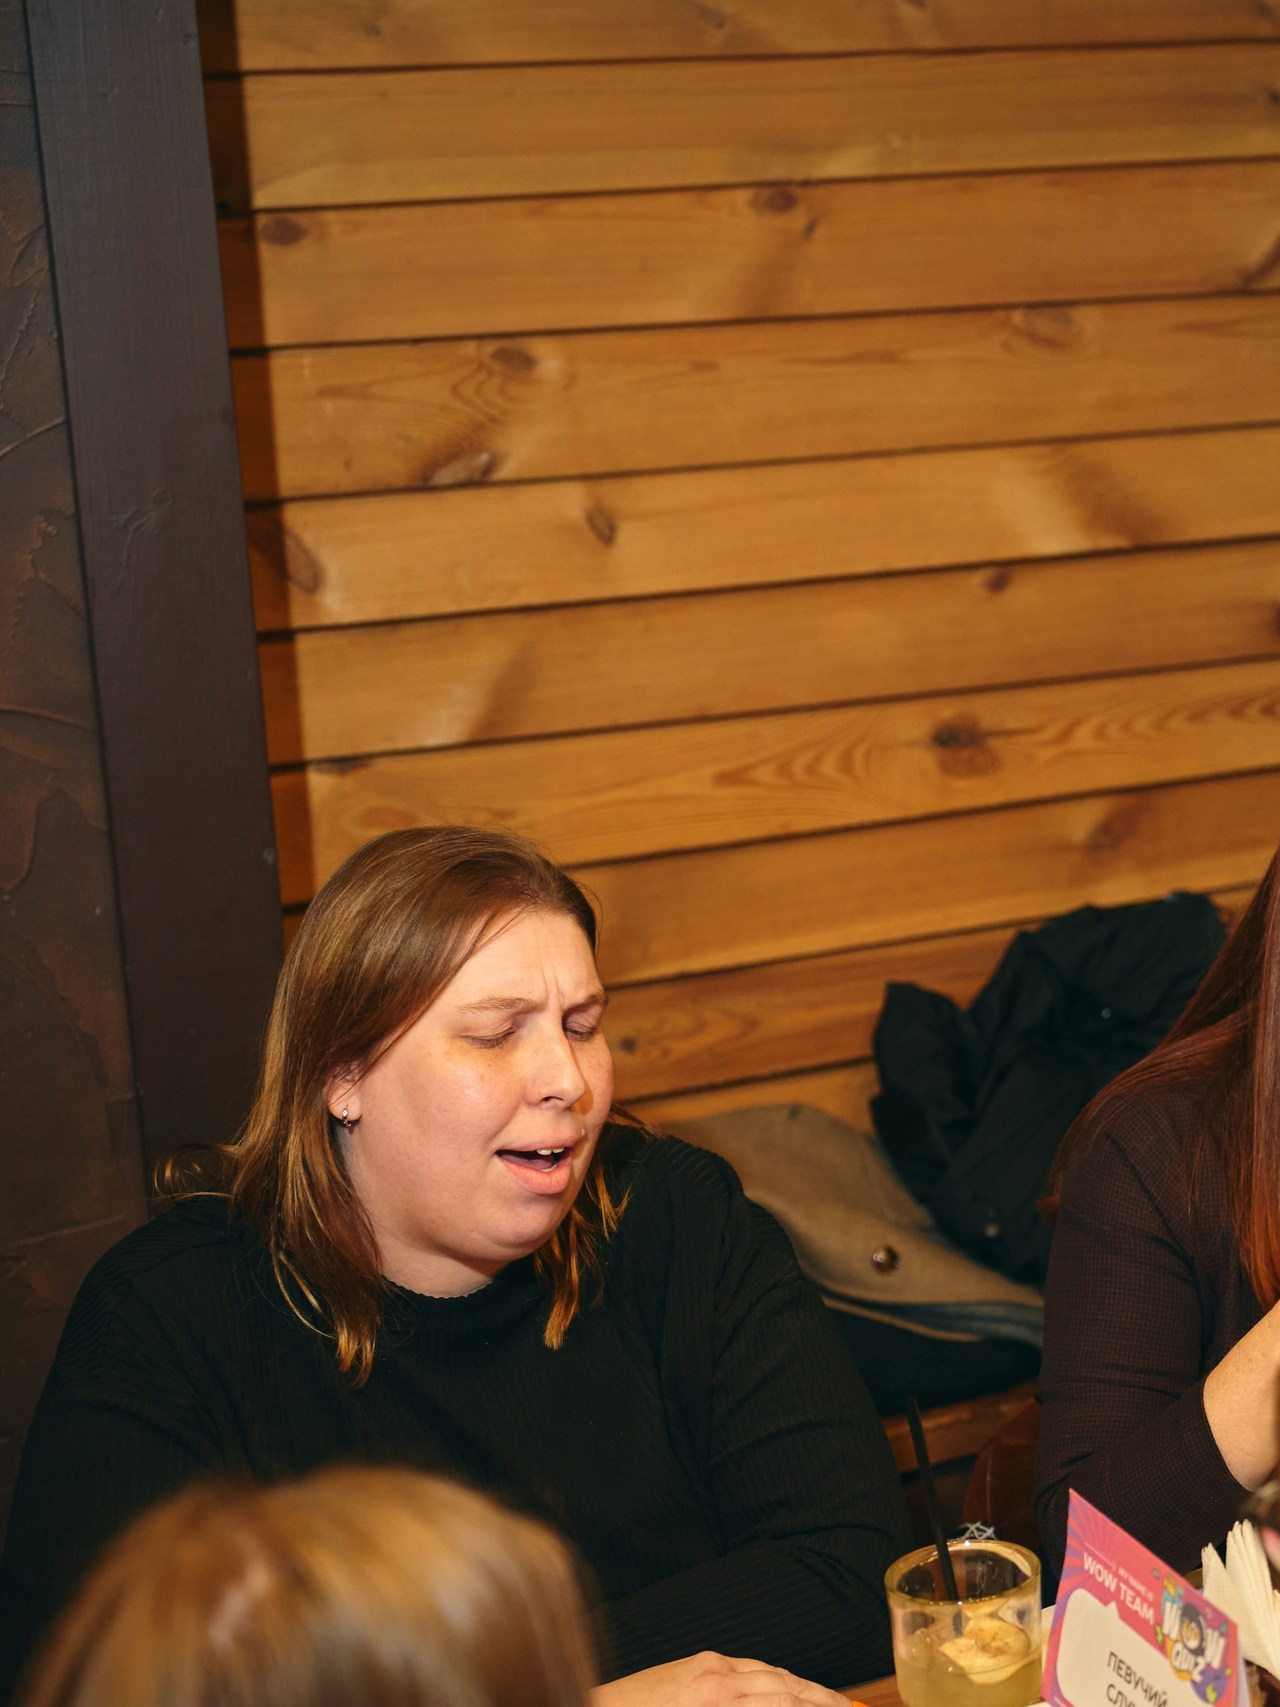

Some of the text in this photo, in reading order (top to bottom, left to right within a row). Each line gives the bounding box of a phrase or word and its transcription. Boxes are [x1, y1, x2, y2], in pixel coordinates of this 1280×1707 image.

[1083, 1552, 1154, 1626] WOW TEAM
[1107, 1651, 1168, 1707] ПЕВУЧИЙ
[1171, 1641, 1205, 1684] QUIZ
